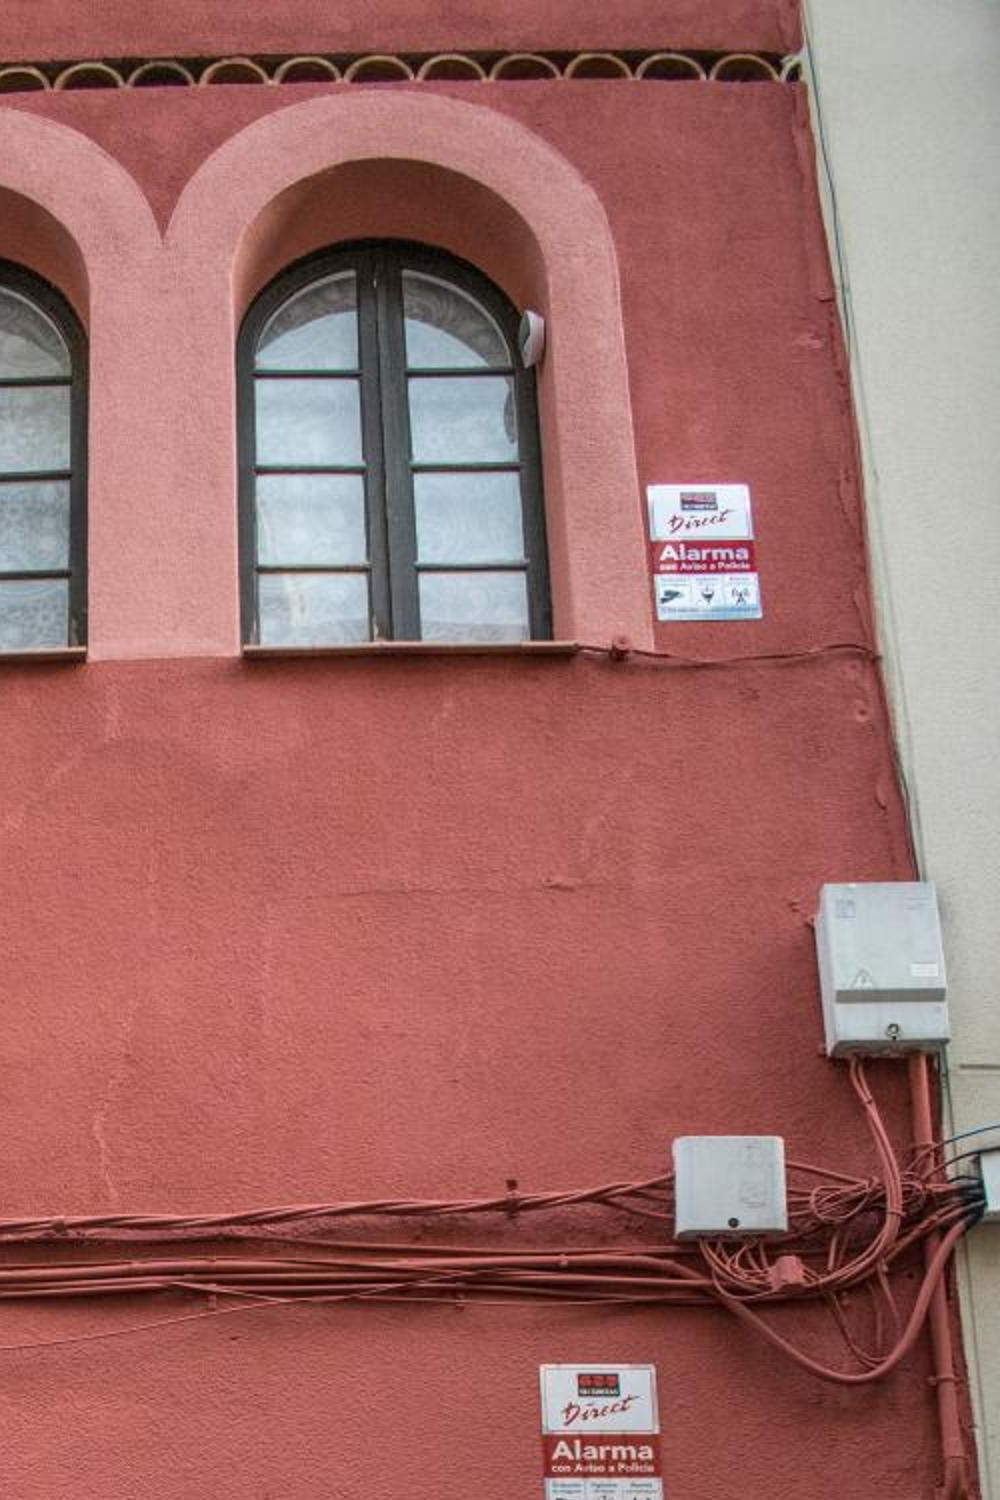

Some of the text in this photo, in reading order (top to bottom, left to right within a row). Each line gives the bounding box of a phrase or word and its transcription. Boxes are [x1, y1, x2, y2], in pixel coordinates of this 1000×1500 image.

[667, 509, 732, 534] Direct
[660, 543, 749, 561] Alarma
[562, 1394, 640, 1426] Direct
[552, 1440, 653, 1460] Alarma
[552, 1465, 571, 1473] con
